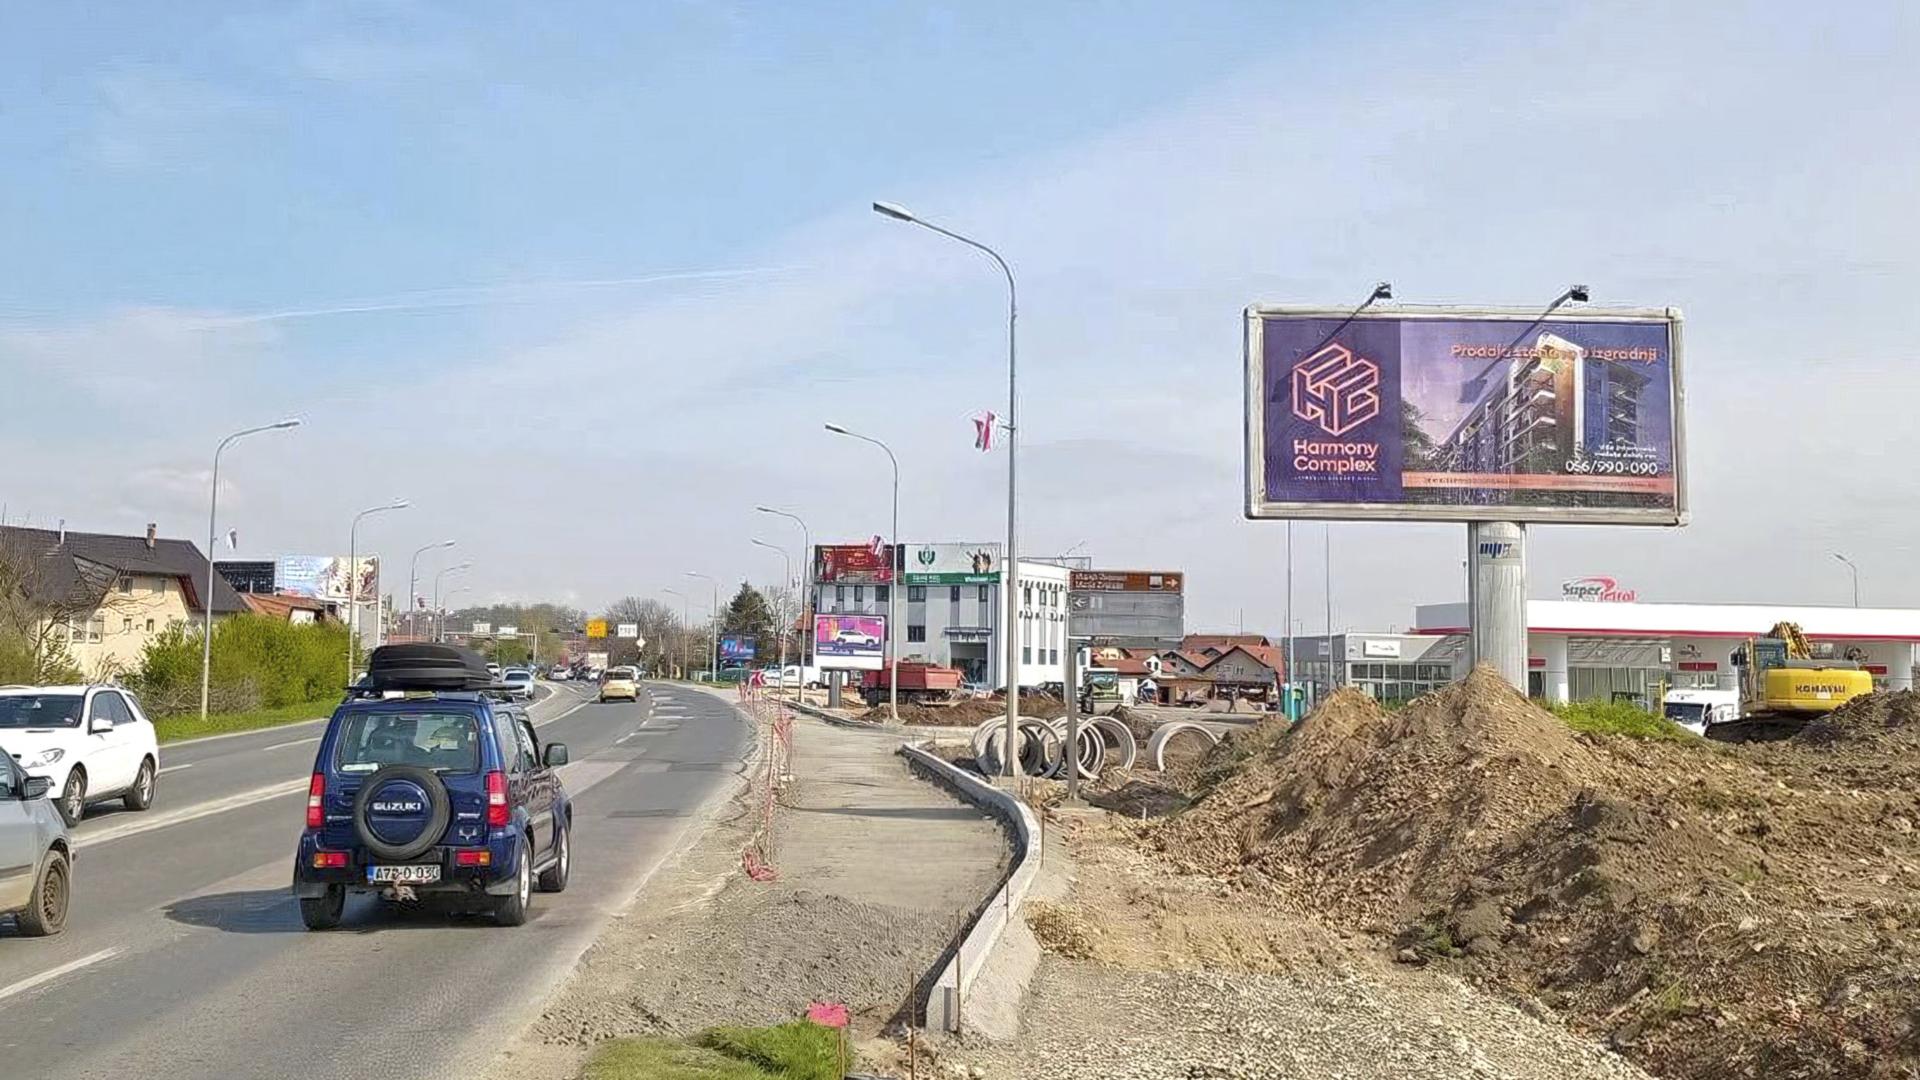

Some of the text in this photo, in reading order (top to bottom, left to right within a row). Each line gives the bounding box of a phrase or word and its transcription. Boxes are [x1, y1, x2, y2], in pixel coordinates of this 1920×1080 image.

[1293, 440, 1379, 459] Harmony
[1293, 456, 1377, 474] Complex
[1562, 583, 1602, 598] Super
[373, 802, 421, 811] SUZUKI
